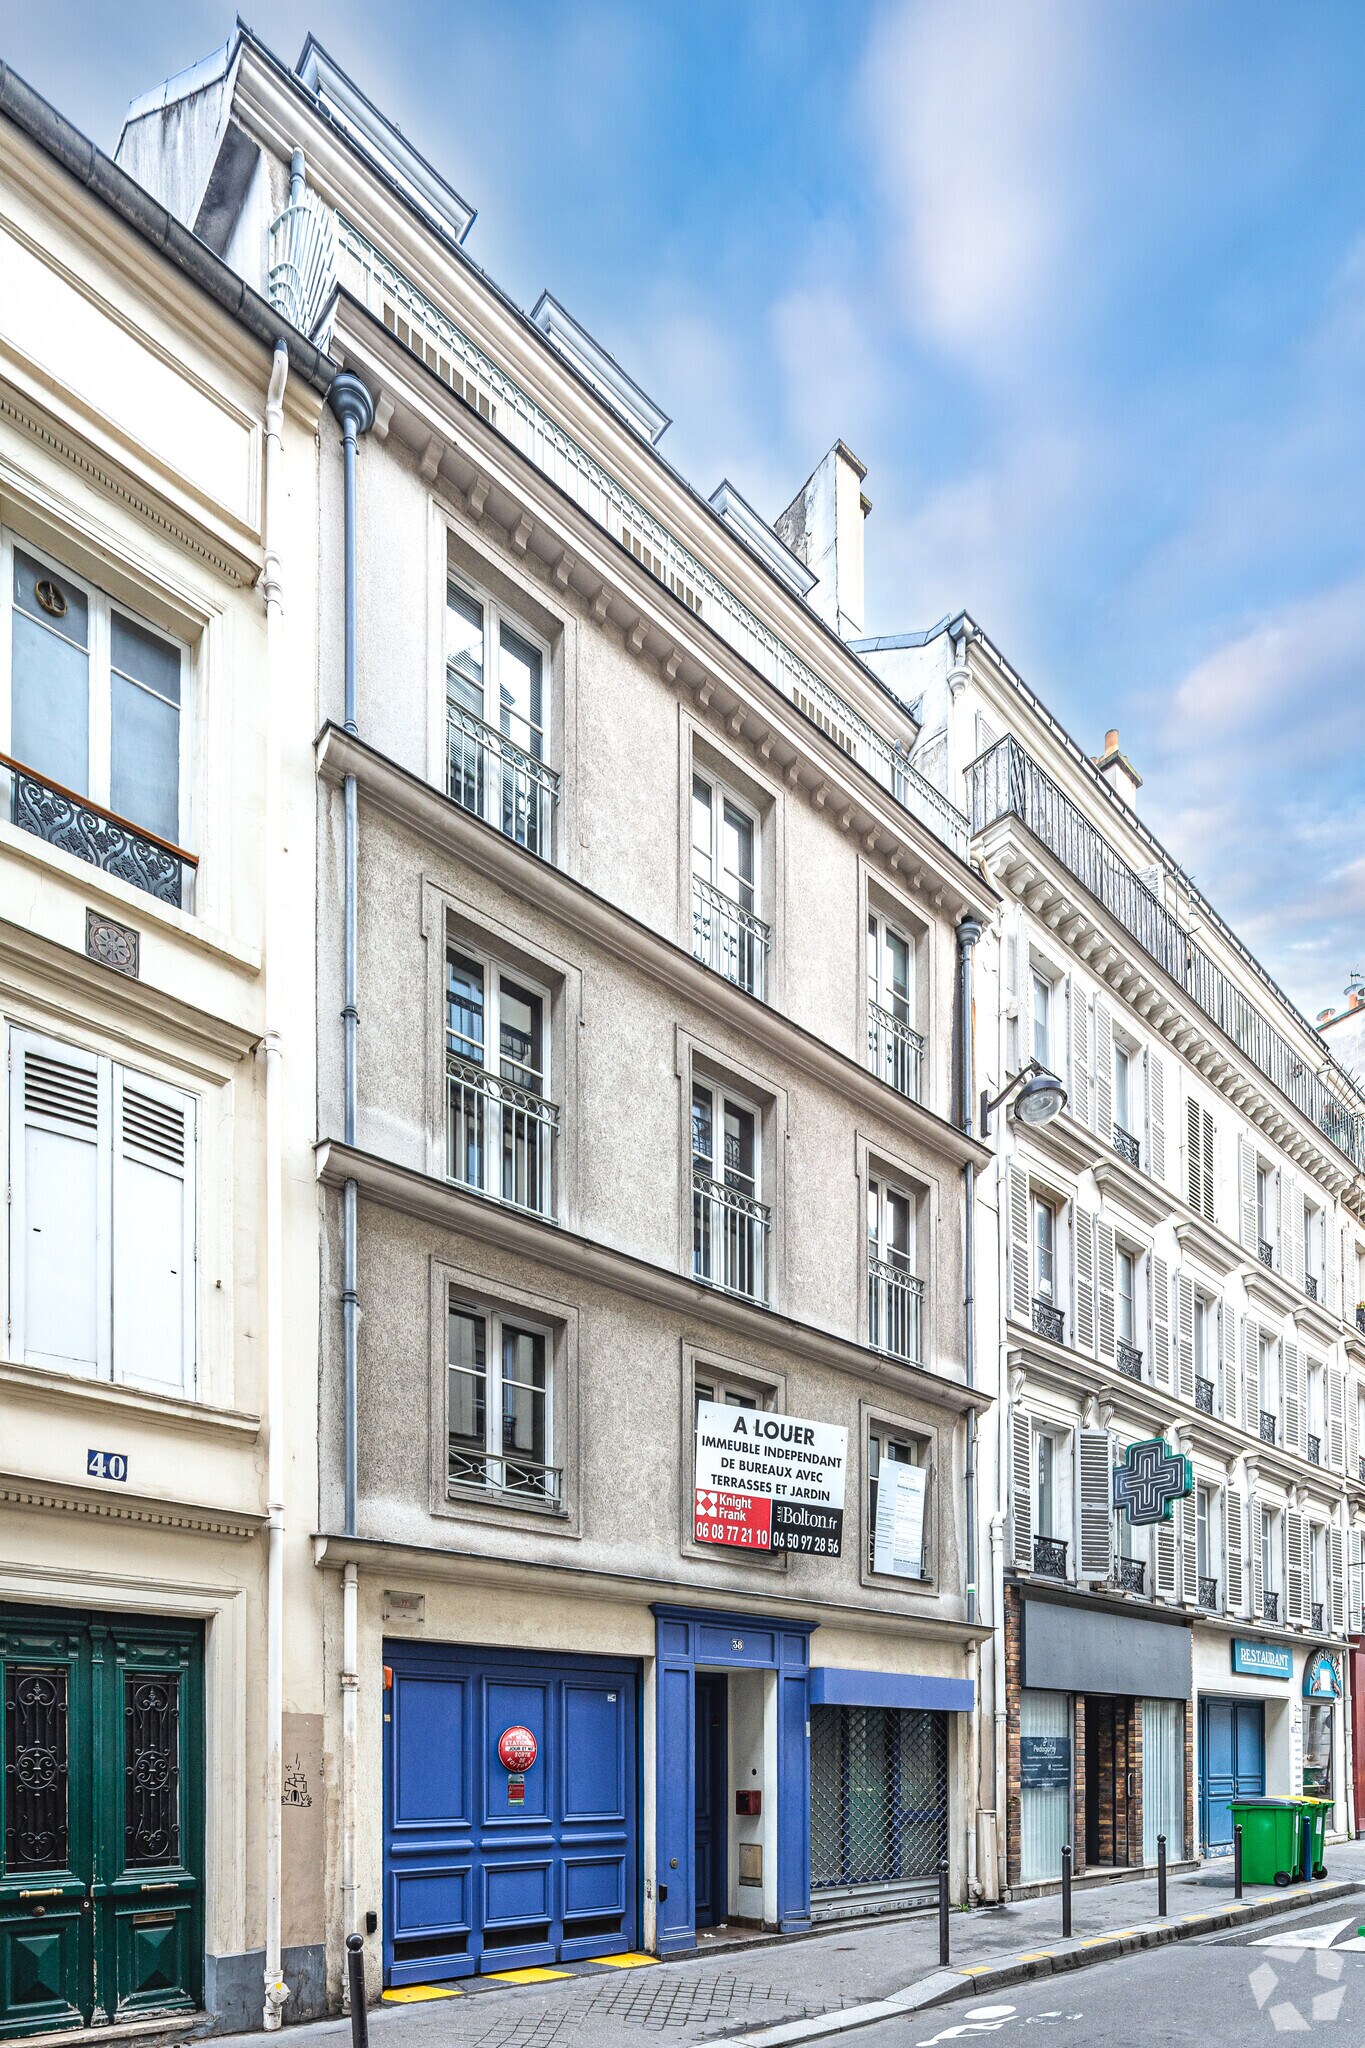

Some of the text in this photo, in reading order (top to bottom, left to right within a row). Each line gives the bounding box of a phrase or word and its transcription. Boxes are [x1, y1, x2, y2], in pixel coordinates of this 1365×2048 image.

[733, 1416, 815, 1446] A LOUER
[702, 1435, 842, 1468] IMMEUBLE INDEPENDANT
[89, 1452, 125, 1479] 40
[721, 1457, 823, 1483] DE BUREAUX AVEC
[711, 1473, 830, 1501] TERRASSES ET JARDIN
[719, 1494, 752, 1510] Knight
[719, 1507, 746, 1522] Frank
[783, 1506, 837, 1530] Bolton.fr
[696, 1522, 768, 1545] 06 08 77 21 10
[773, 1531, 839, 1554] 06 50 97 28 56
[732, 1640, 743, 1650] 38
[1240, 1648, 1289, 1667] RESTAURANT
